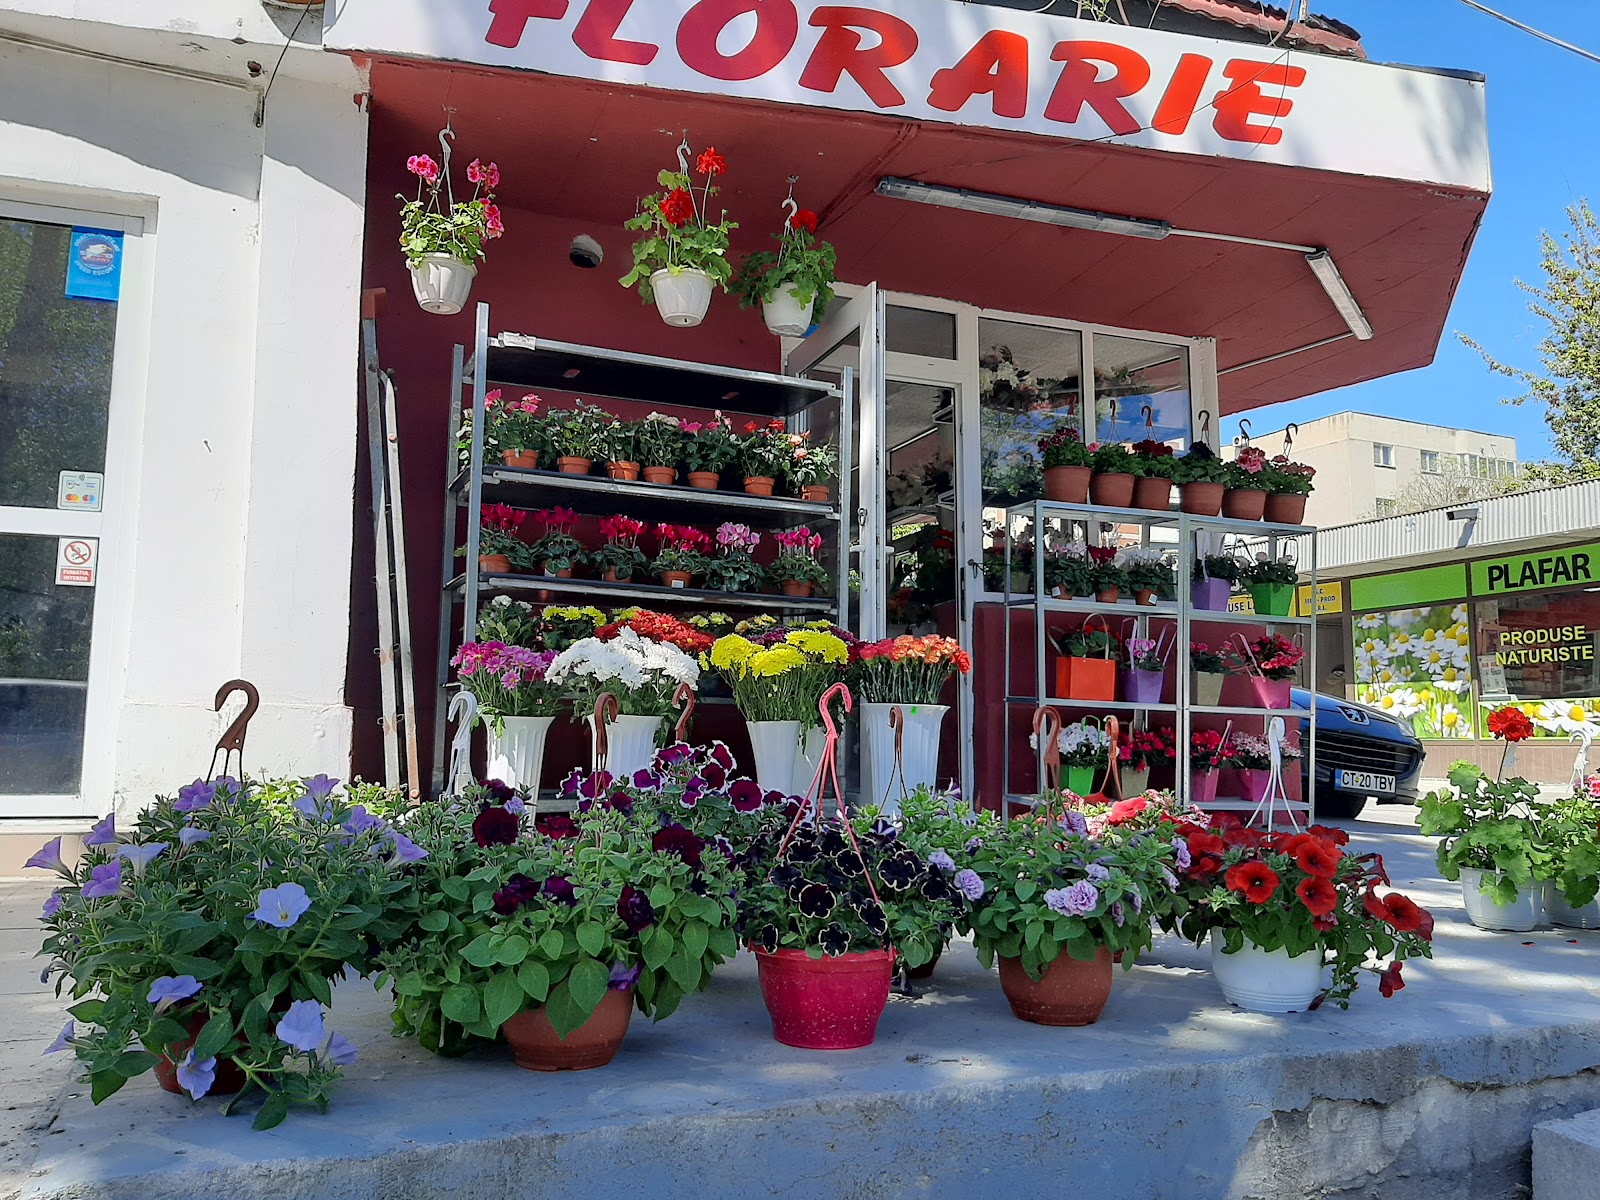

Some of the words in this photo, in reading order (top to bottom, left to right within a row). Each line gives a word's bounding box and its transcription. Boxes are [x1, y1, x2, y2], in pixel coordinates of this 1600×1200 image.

[93, 264, 116, 276] ESCORT
[1488, 553, 1592, 591] PLAFAR
[1500, 625, 1587, 646] PRODUSE
[1495, 645, 1595, 666] NATURISTE
[1342, 771, 1356, 787] CT
[1359, 773, 1371, 788] 20
[1373, 775, 1394, 791] TBY
